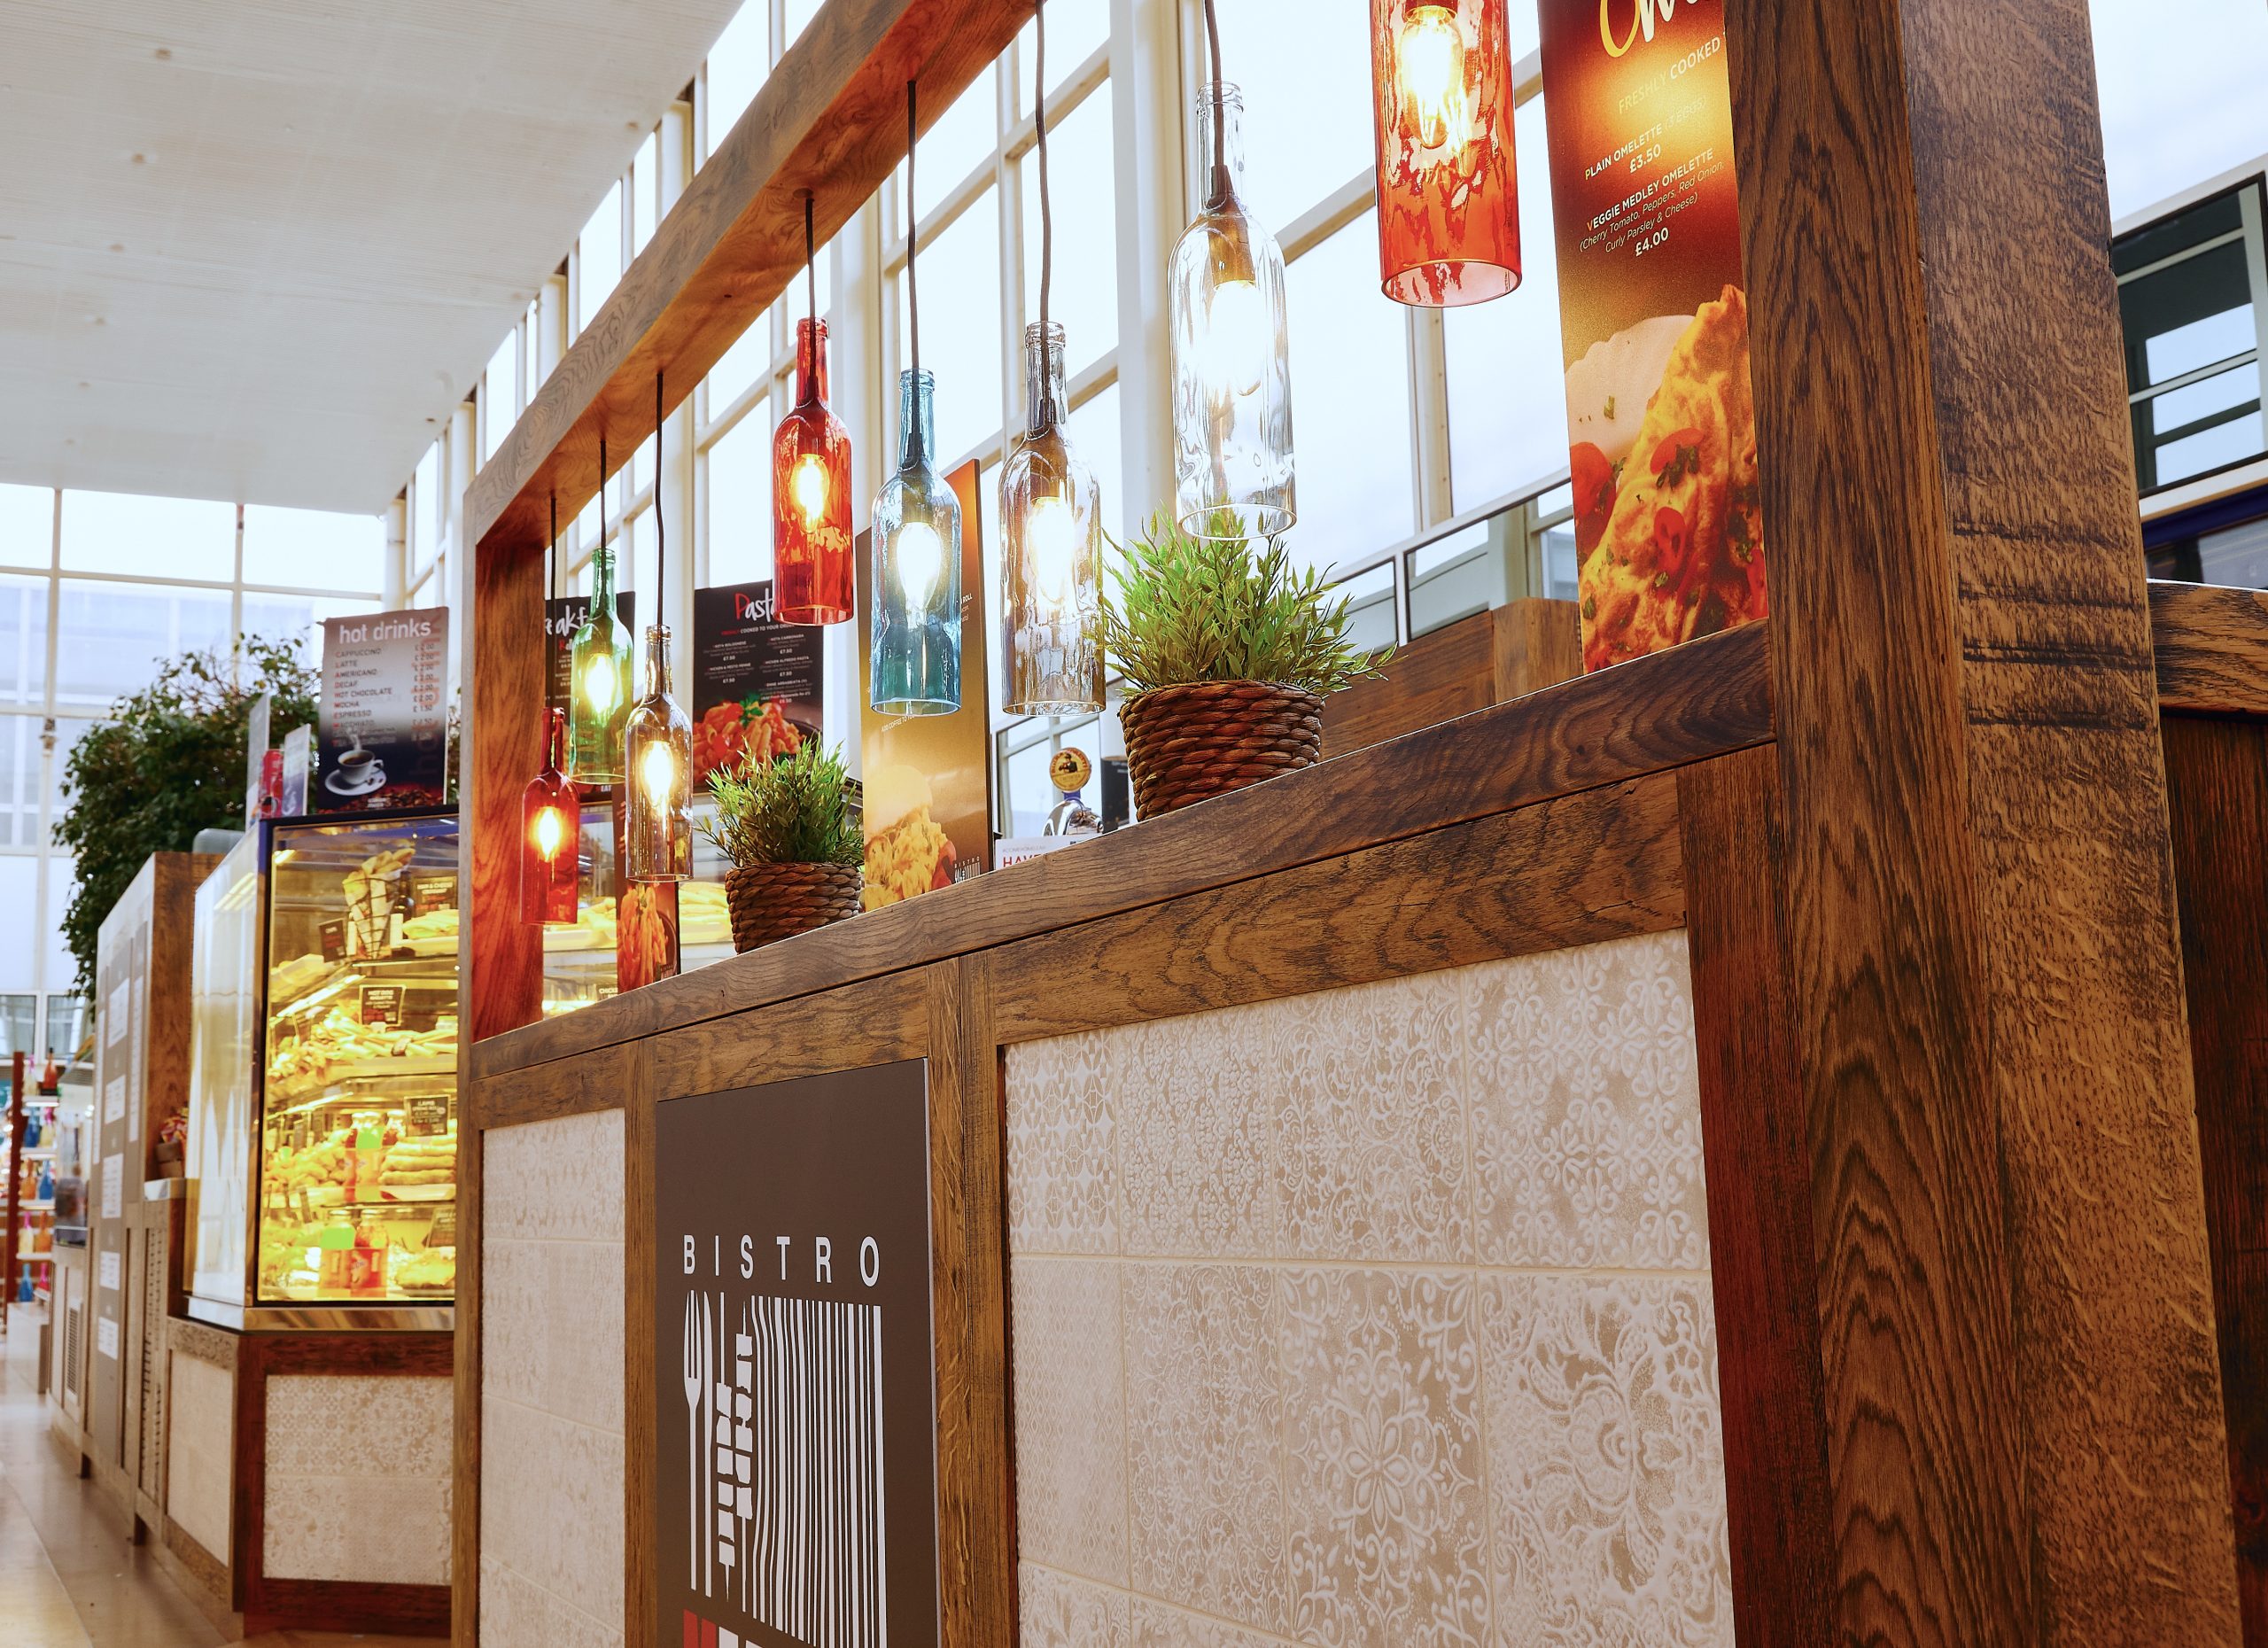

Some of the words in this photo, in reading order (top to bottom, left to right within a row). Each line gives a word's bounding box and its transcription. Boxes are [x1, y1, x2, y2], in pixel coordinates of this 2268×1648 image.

[1618, 71, 1667, 114] FRESHLY
[1670, 36, 1720, 80] COOKED
[1585, 155, 1612, 180] PLAIN
[1613, 123, 1662, 162] OMELETTE
[1629, 144, 1661, 173] £3.50
[1587, 204, 1620, 231] VEGGIE
[1622, 180, 1659, 209] MEDLEY
[1662, 148, 1713, 186] OMELETTE
[1580, 229, 1607, 252] (Cherry
[1609, 211, 1641, 233] Tomato,
[1643, 190, 1676, 214] Peppers,
[1679, 175, 1695, 193] Red
[1605, 236, 1625, 253] Curly
[1627, 217, 1656, 241] Parsley
[1657, 213, 1663, 223] &
[1665, 192, 1698, 218] Cheese)
[1635, 227, 1669, 256] £4.00
[339, 623, 368, 644] hot
[373, 618, 431, 641] drinks
[335, 648, 382, 658] CAPPUCCINO
[335, 659, 358, 668] LATTE
[335, 668, 377, 678] AMERICANO
[350, 688, 392, 697] CHOCOLATE
[333, 710, 371, 719] ESPRESSO
[889, 718, 902, 729] COFFEE
[954, 856, 980, 869] BISTRO
[1003, 853, 1042, 867] HAV
[684, 1234, 881, 1287] BISTRO
